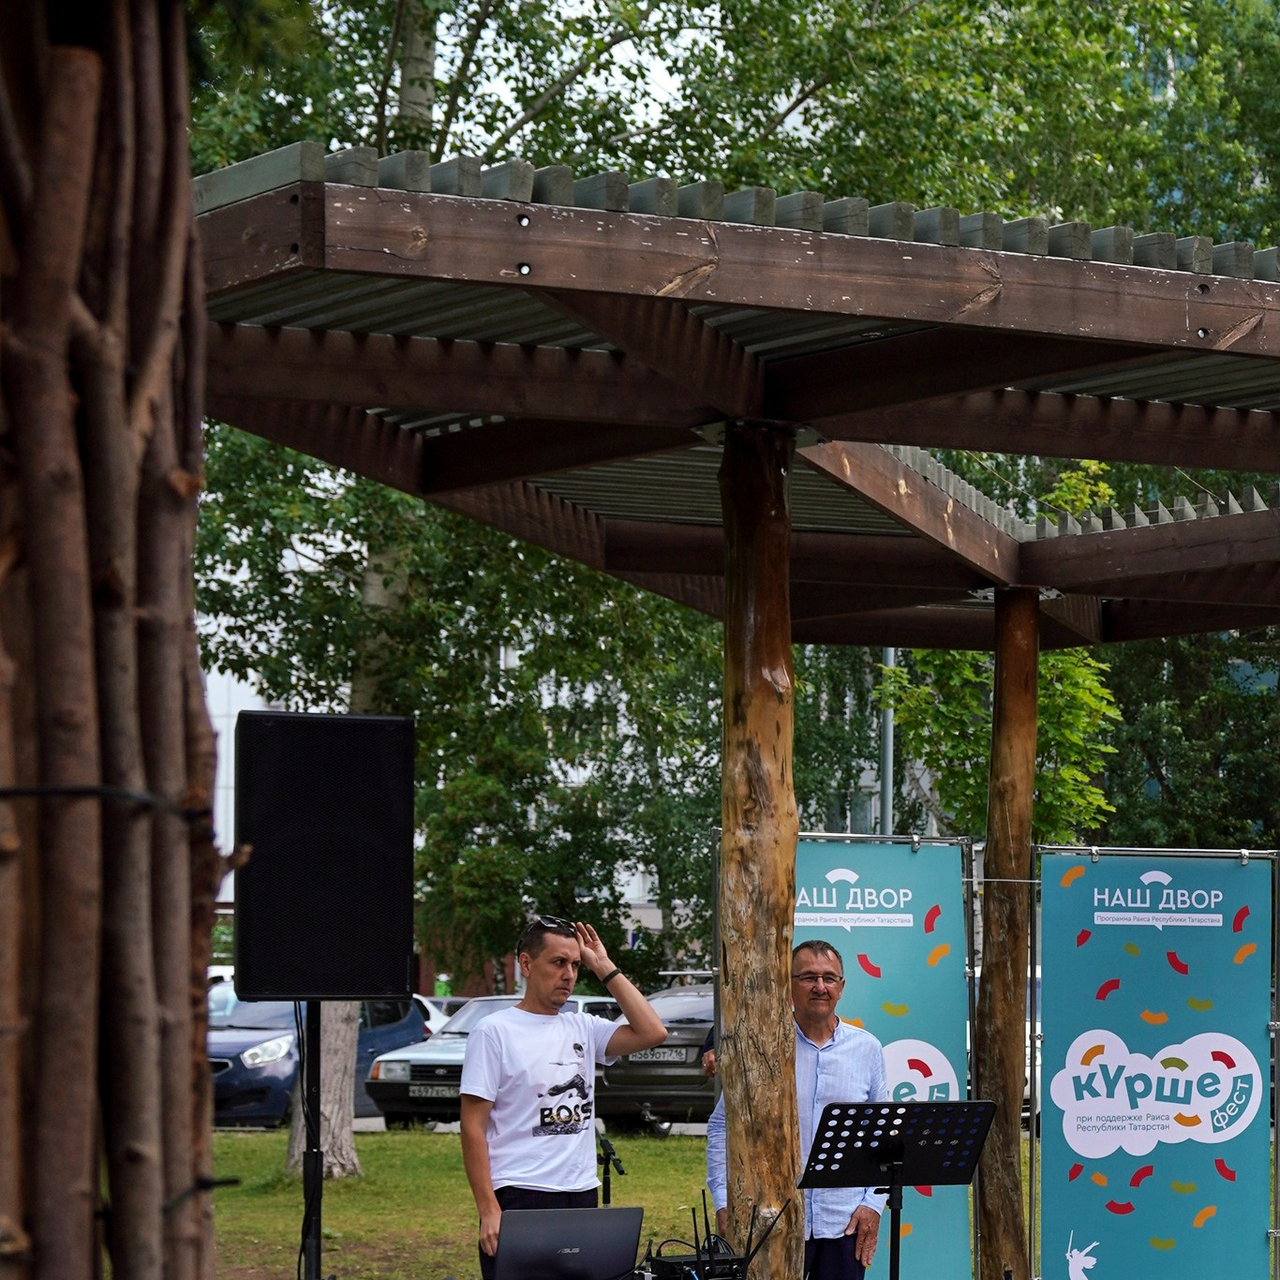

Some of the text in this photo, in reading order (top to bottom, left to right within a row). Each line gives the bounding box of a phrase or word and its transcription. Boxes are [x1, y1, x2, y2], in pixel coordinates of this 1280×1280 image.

[796, 887, 912, 910] АШ ДВОР
[1094, 887, 1223, 911] НАШ ДВОР
[820, 916, 838, 924] Раиса
[839, 916, 876, 925] Республики
[1096, 915, 1132, 924] Программа
[1152, 916, 1187, 925] Республики
[1188, 917, 1221, 925] Татарстана
[1212, 1078, 1250, 1129] фест
[1076, 1112, 1170, 1123] при поддержке Раиса
[1076, 1122, 1170, 1133] Республики Татарстан
